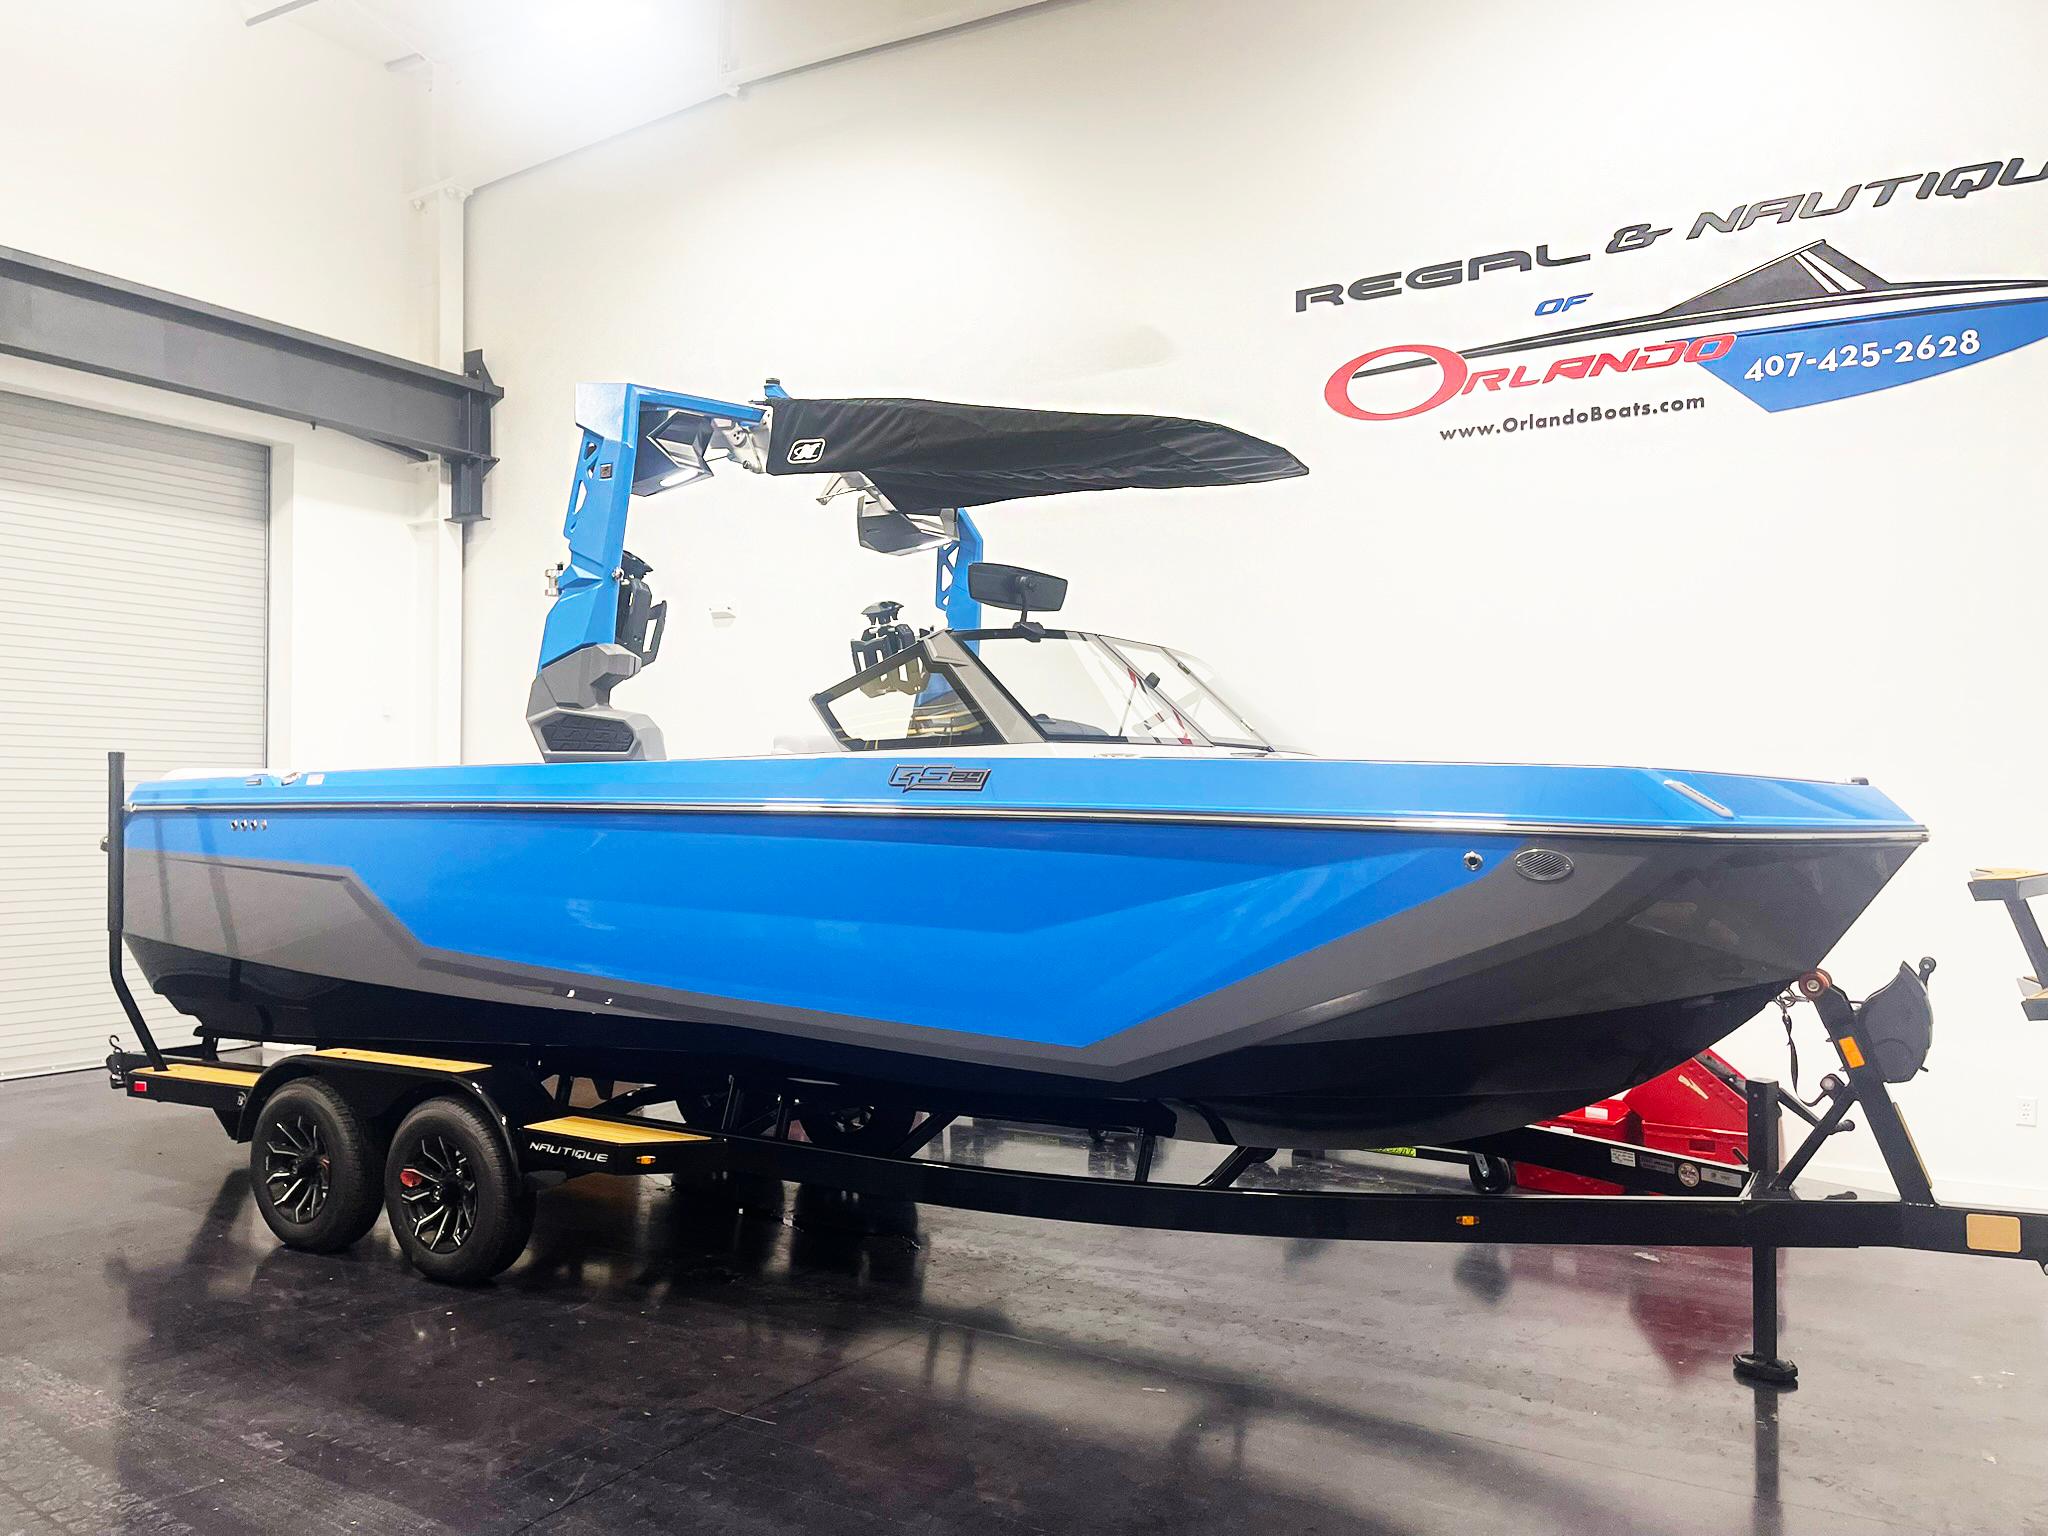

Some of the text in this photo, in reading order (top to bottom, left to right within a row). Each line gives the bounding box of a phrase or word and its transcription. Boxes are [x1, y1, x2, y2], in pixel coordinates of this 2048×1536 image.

[1295, 157, 2048, 313] REGAL & NAUTIQU
[1534, 292, 1594, 316] OF
[1324, 333, 1736, 421] ORLANDO
[1743, 329, 1981, 382] 407-425-2628
[1440, 396, 1706, 441] www.OrlandoBoats.com
[529, 1141, 609, 1163] NAUTIQUE
